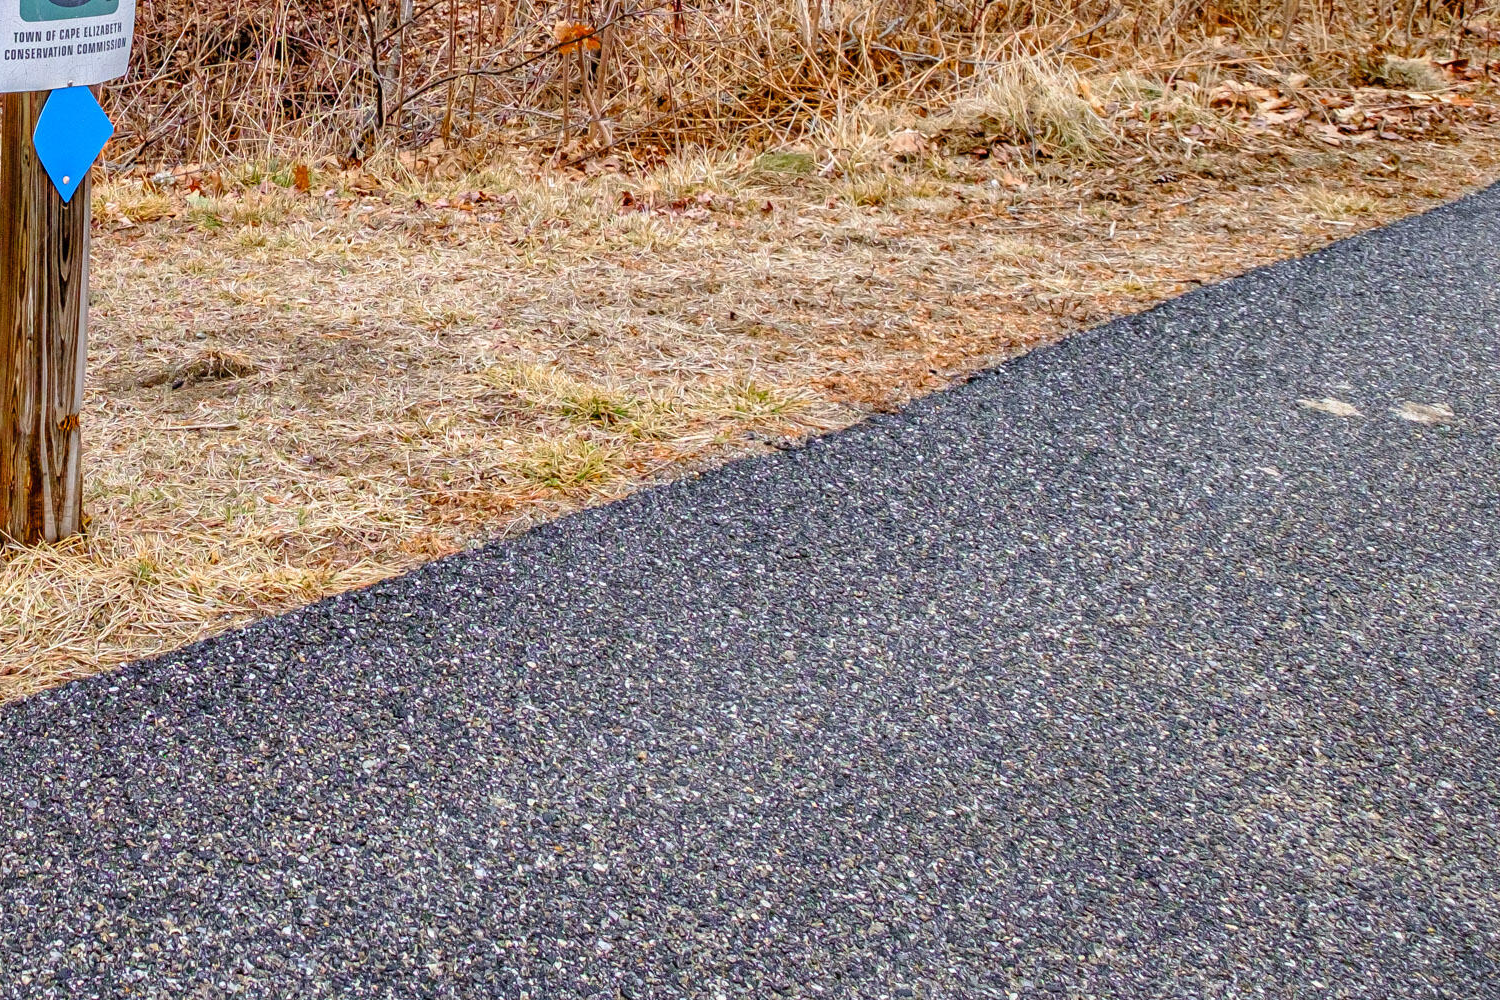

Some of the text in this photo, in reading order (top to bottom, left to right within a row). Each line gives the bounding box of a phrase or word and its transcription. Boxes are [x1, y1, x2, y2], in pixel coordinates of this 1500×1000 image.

[14, 22, 122, 43] TOWN OF CAPE ELIZABETH
[4, 37, 126, 60] CONSERVATION COMMISSION
